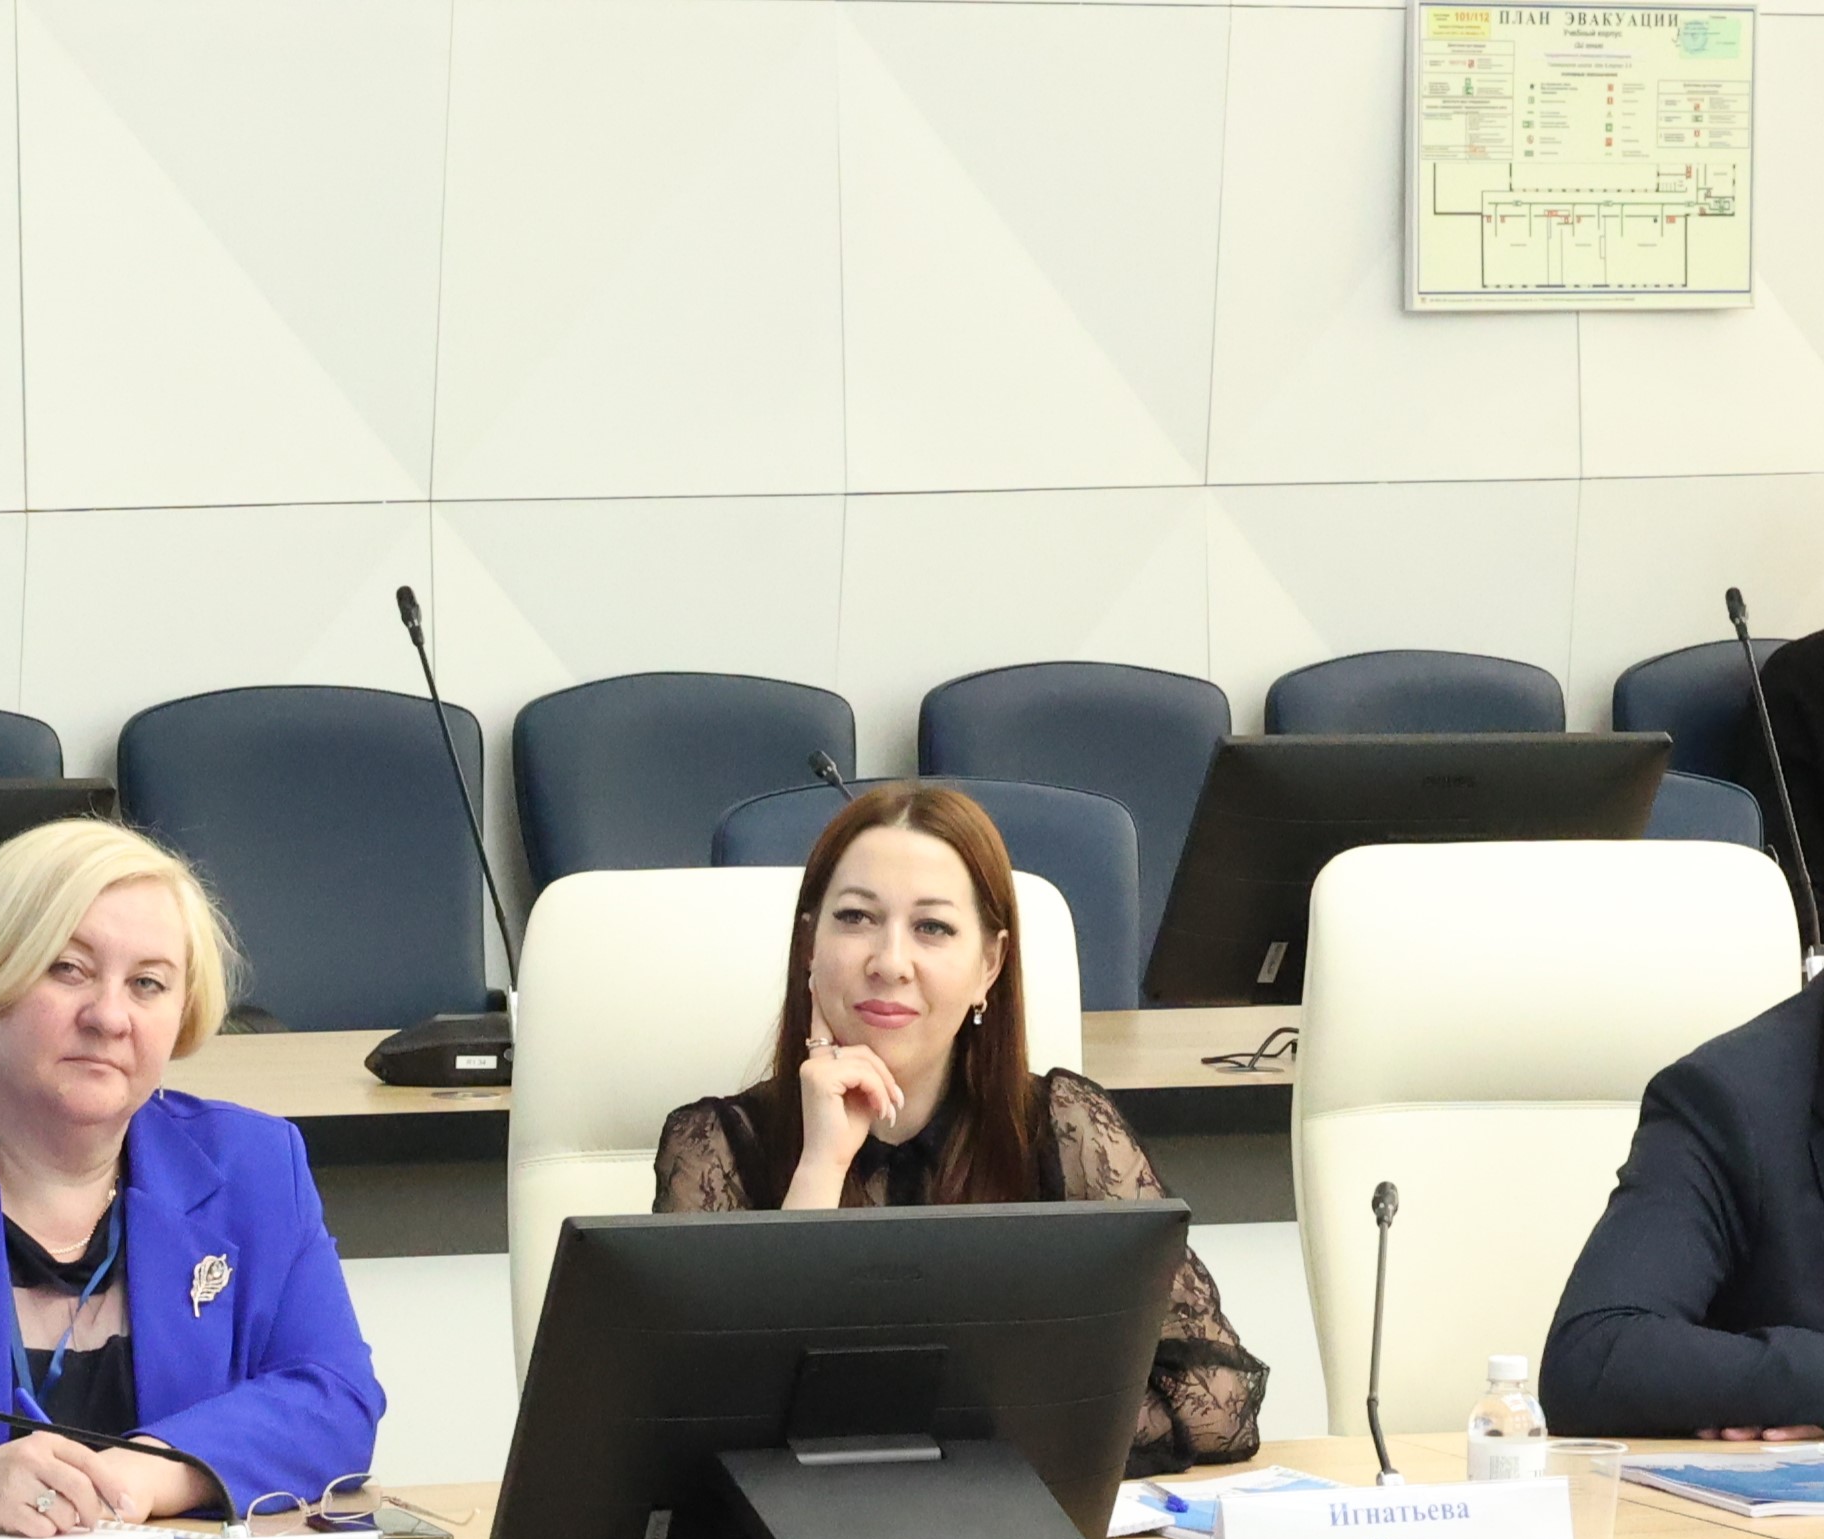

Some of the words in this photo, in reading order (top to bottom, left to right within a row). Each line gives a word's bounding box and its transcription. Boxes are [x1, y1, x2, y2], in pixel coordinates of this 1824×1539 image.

[1455, 11, 1490, 23] 101/112
[1499, 10, 1550, 25] ПЛАН
[1565, 11, 1678, 28] ЭВАКУАЦИИ
[1329, 1501, 1470, 1526] Игнатьева
